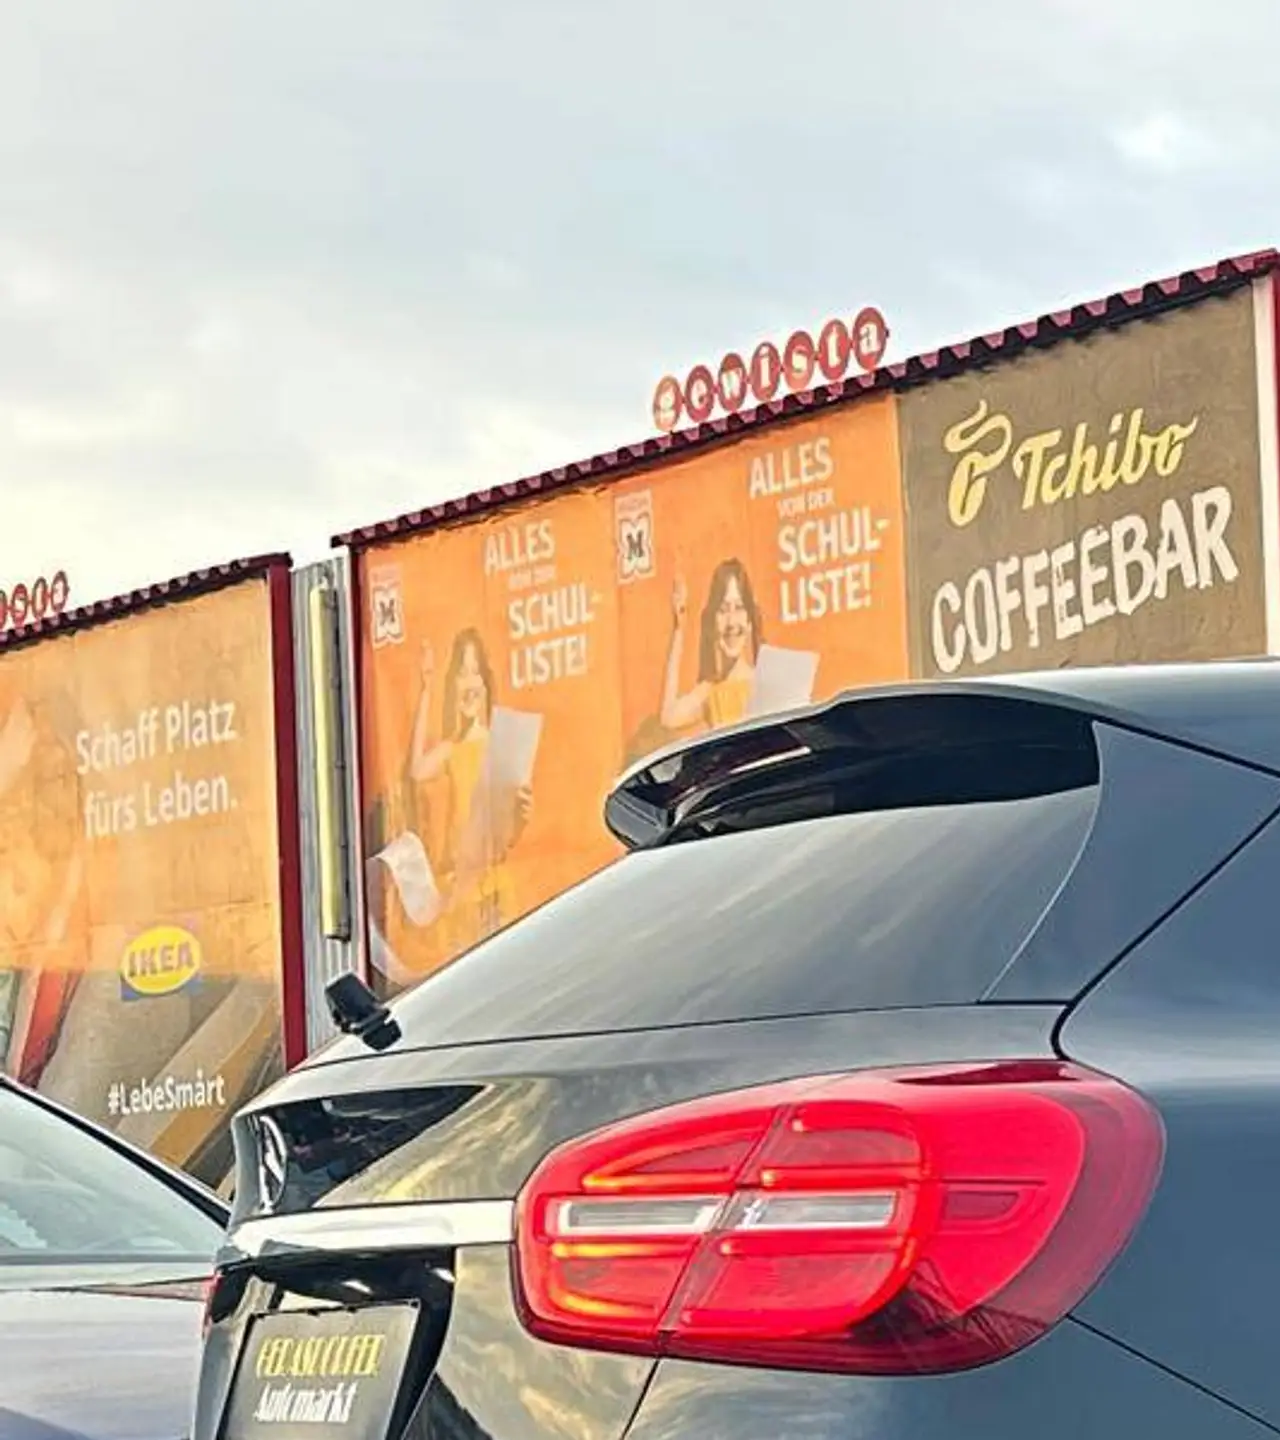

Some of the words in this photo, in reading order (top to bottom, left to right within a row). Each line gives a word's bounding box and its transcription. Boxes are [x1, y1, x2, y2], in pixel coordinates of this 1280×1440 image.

[750, 438, 834, 499] ALLES
[1013, 408, 1198, 510] Tchibo
[485, 519, 555, 576] ALLES
[777, 507, 890, 572] SCHUL-
[781, 562, 872, 623] LISTE!
[931, 486, 1239, 673] COFFEEBAR
[509, 582, 602, 640] SCHUL-
[511, 634, 588, 689] LISTE!
[76, 707, 159, 775] Schaff
[166, 699, 237, 753] Platz
[86, 790, 137, 839] fürs
[144, 770, 239, 826] Leben.
[129, 941, 194, 977] IKEA
